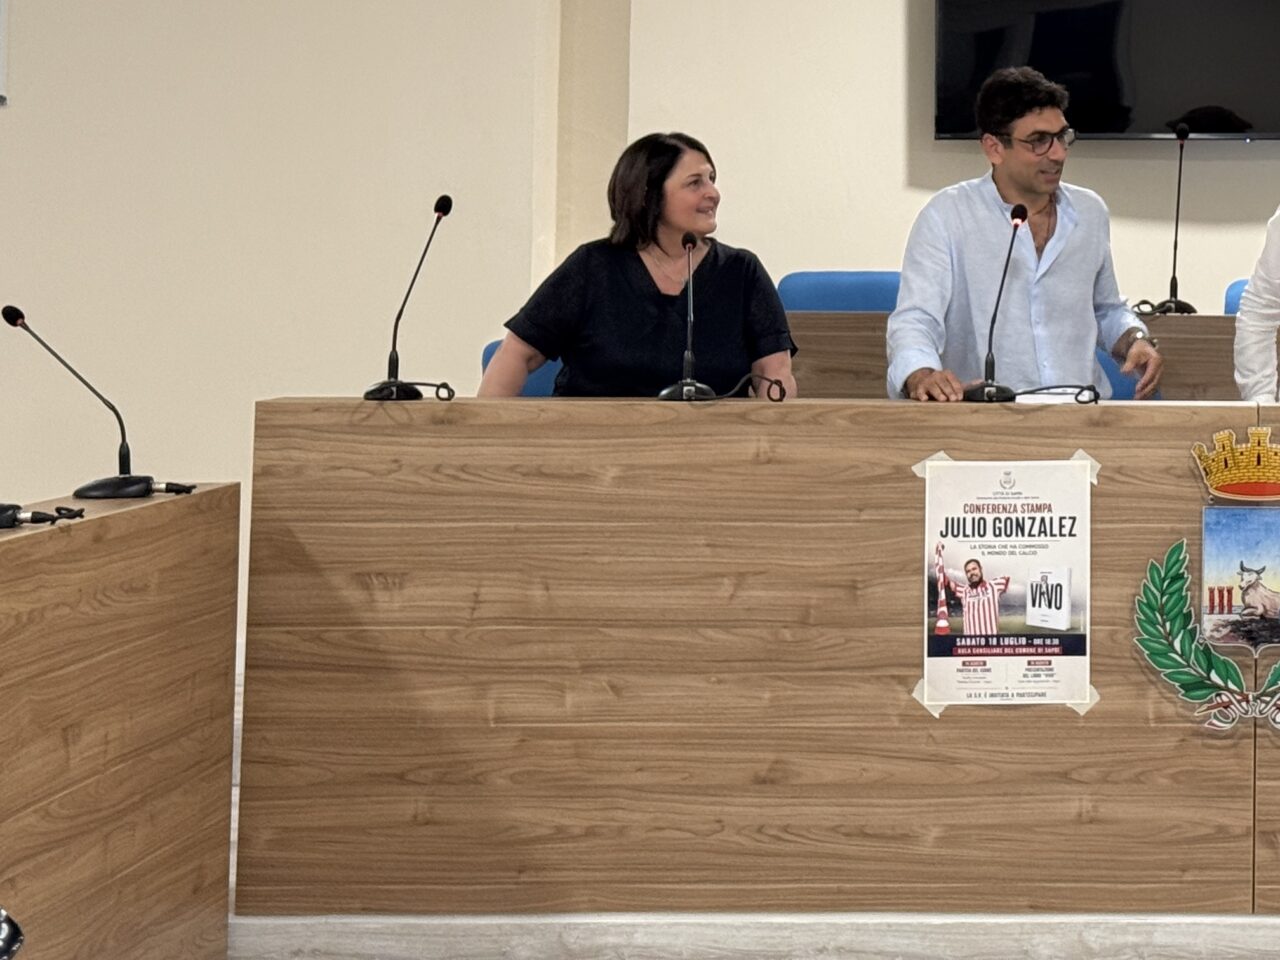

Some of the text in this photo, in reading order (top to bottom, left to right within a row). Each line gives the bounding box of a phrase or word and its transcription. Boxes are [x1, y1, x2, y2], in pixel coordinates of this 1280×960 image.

[963, 503, 1053, 514] CONFERENZA STAMPA
[940, 516, 1077, 538] JULIO GONZALEZ
[956, 637, 986, 646] SABATO
[1000, 637, 1027, 645] LUGLIO
